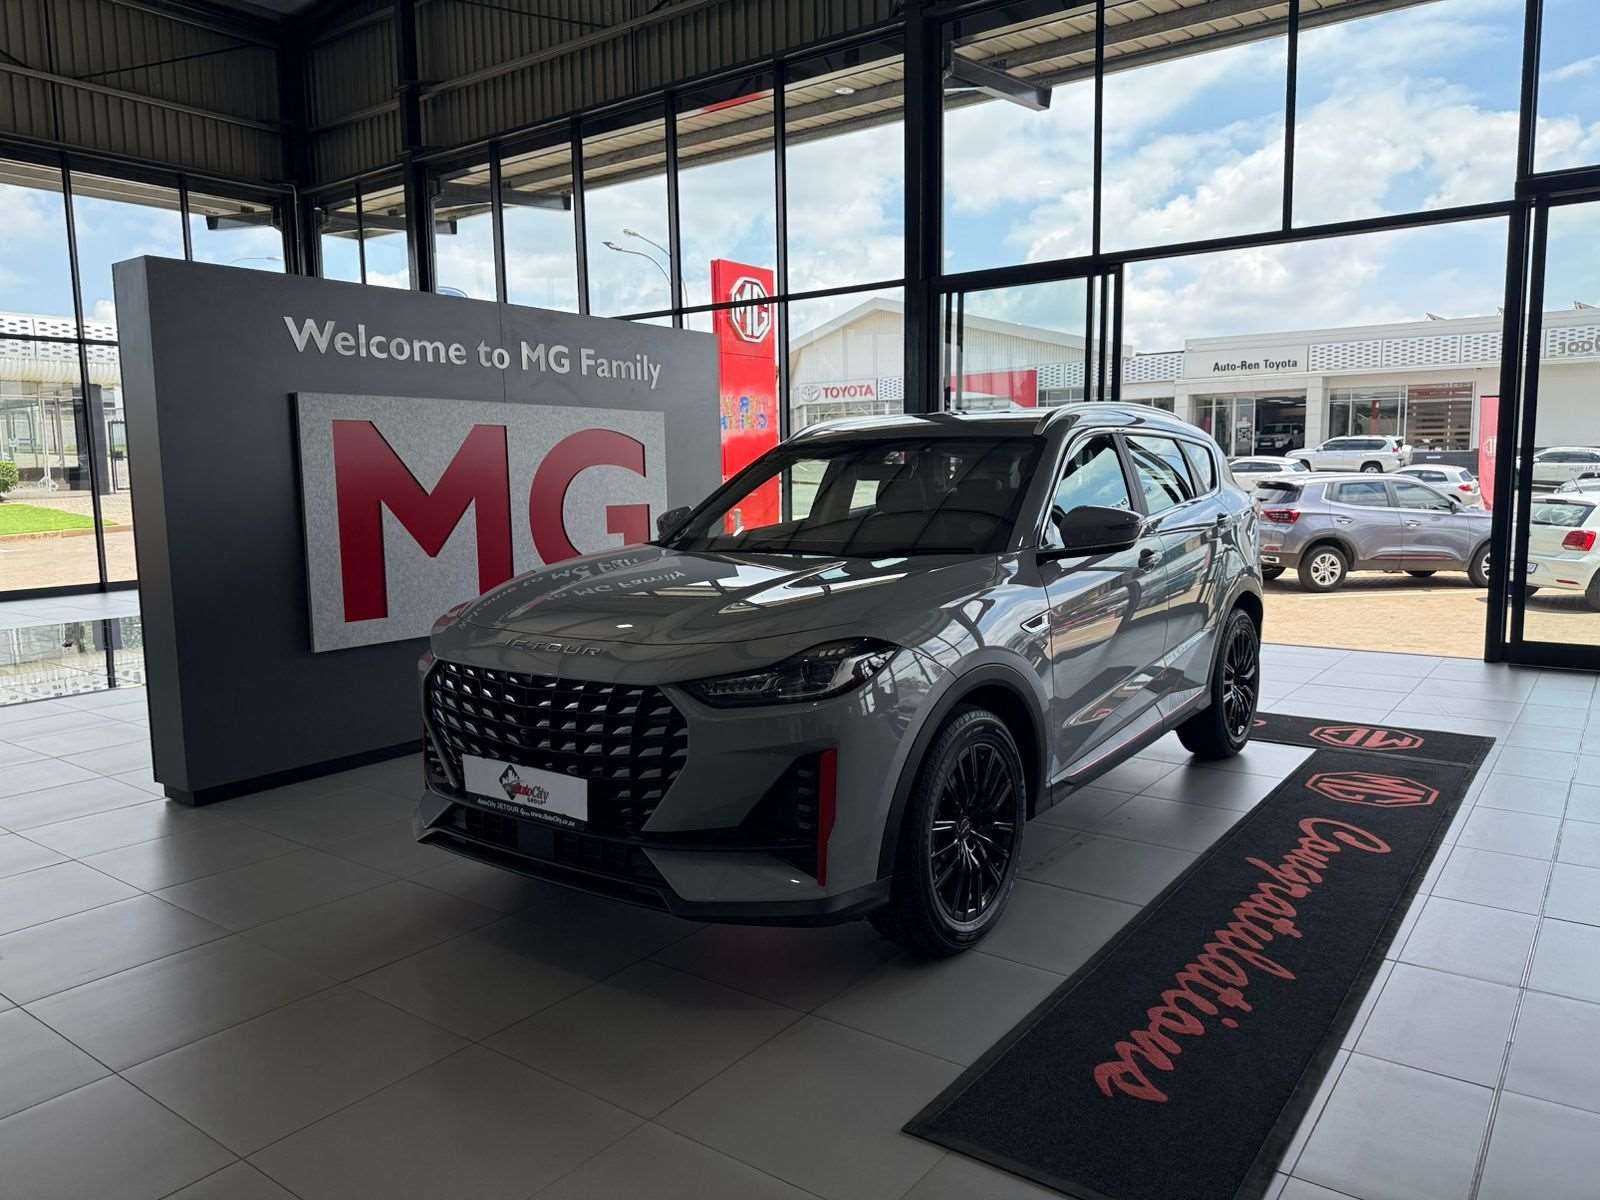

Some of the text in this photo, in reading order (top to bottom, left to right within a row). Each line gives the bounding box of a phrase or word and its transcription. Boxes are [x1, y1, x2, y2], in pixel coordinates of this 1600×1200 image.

[732, 279, 770, 340] MG
[283, 316, 661, 389] Welcome to MG Family
[1212, 359, 1298, 372] Auto-Ren Toyota
[822, 384, 874, 399] TOYOTA
[332, 420, 650, 622] MG
[1316, 726, 1418, 749] MG
[1312, 772, 1432, 806] MG
[1094, 817, 1391, 1101] Congratulations
